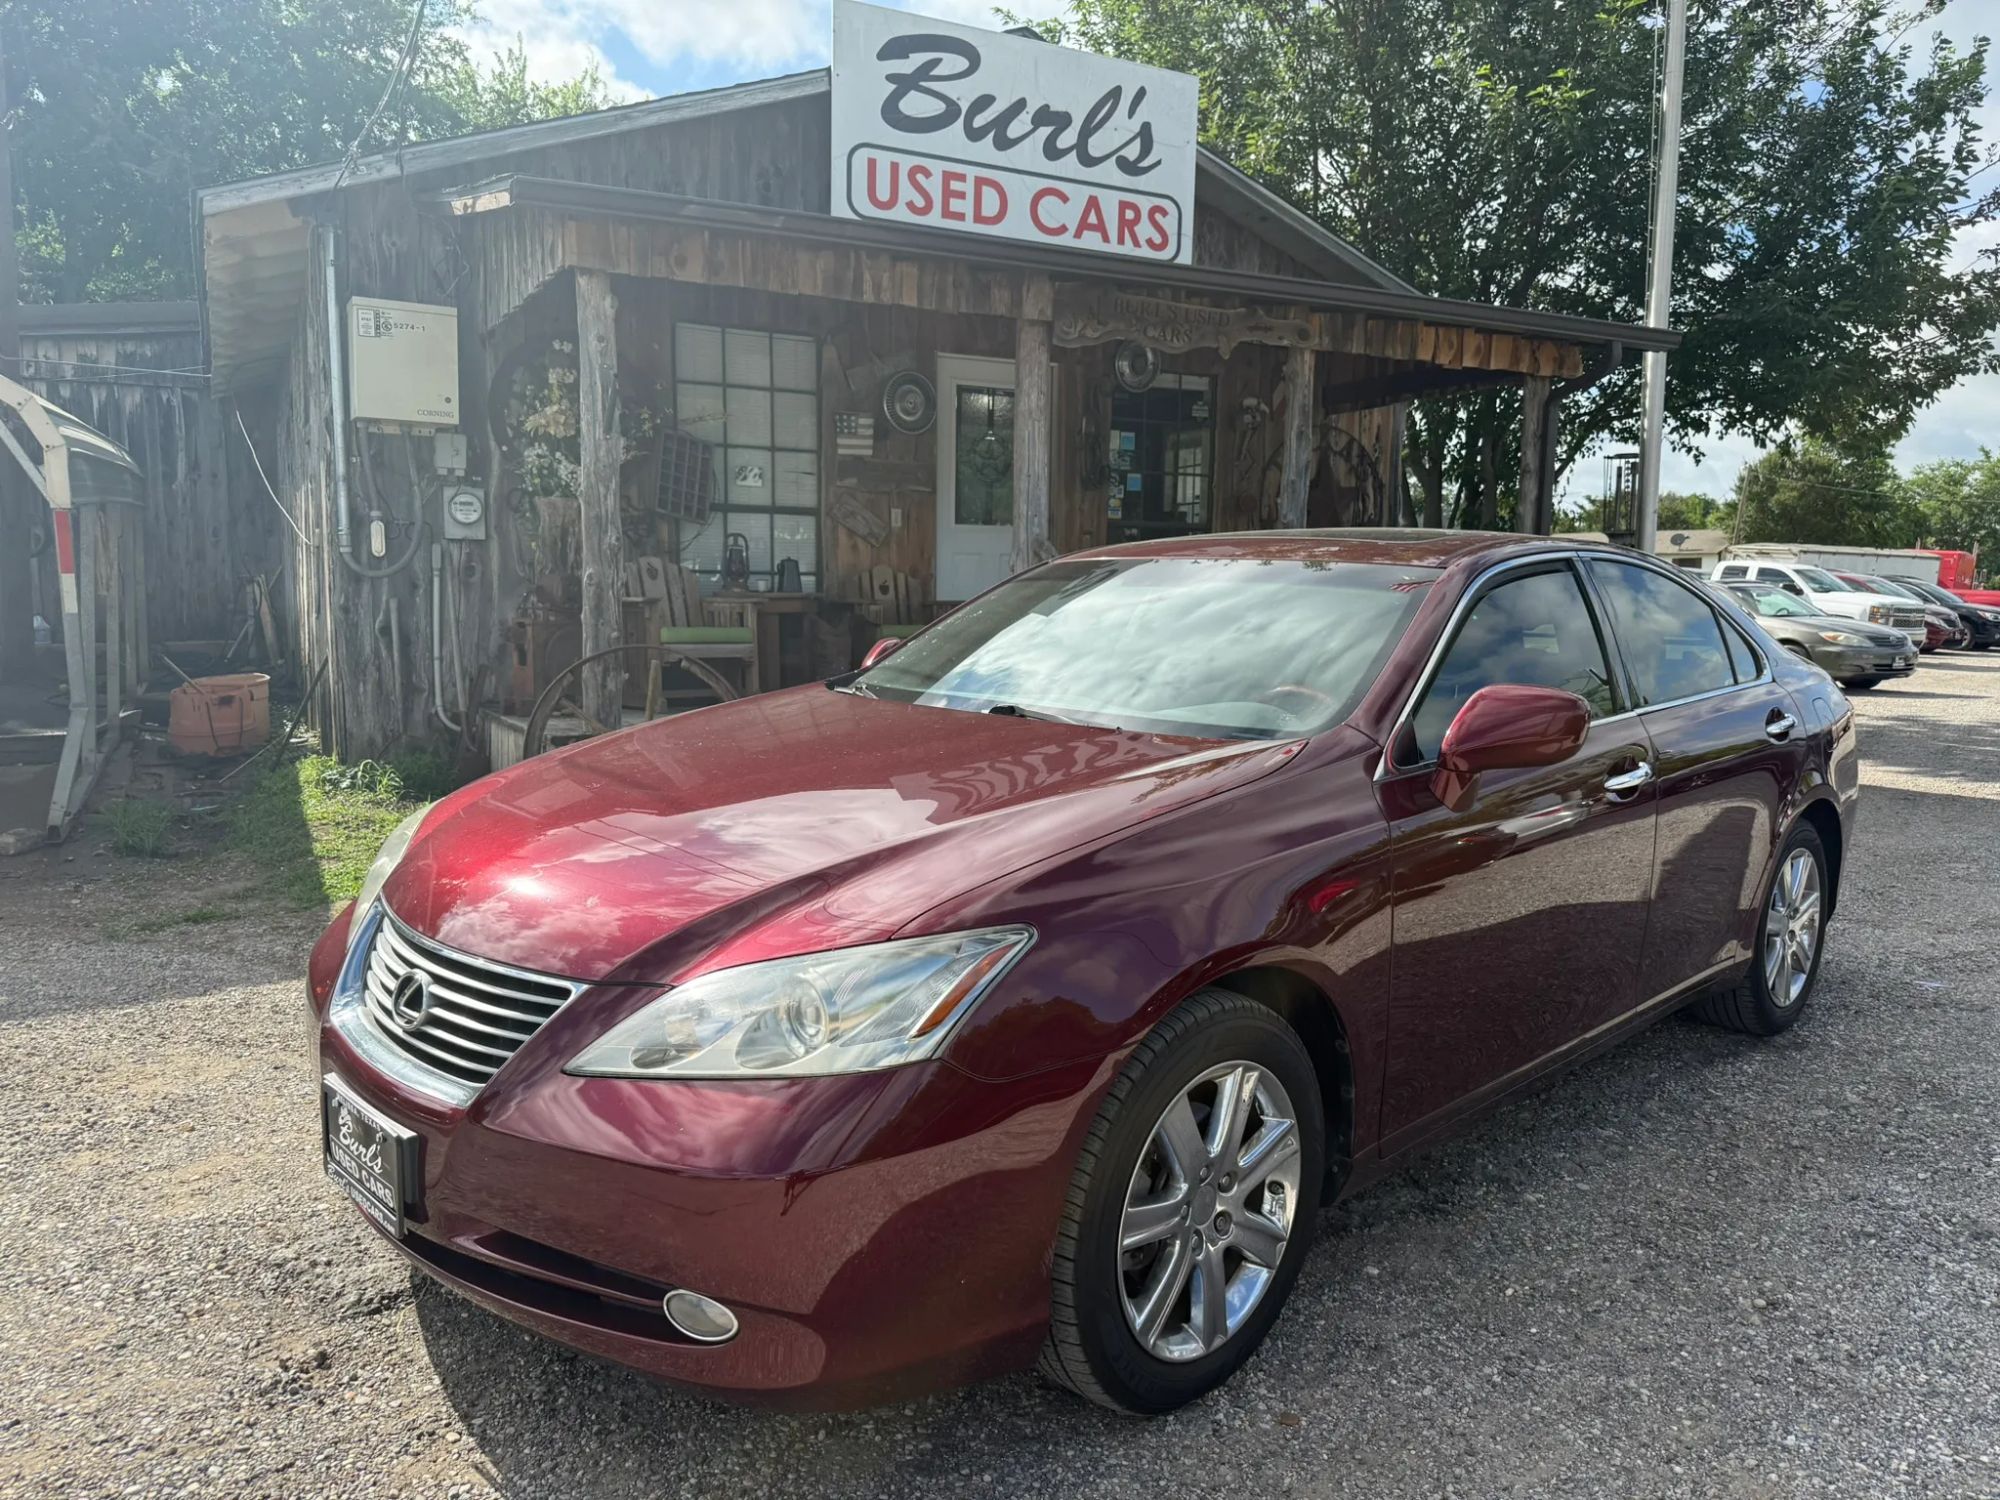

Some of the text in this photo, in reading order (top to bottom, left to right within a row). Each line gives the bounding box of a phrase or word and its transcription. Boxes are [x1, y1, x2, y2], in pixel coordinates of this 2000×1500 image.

[876, 33, 1162, 177] Burl's
[866, 157, 1170, 253] USED CARS
[393, 322, 426, 332] 5274-1
[1143, 325, 1193, 343] CARS
[416, 408, 455, 419] CORNING
[338, 1110, 383, 1174] Burl's
[331, 1141, 394, 1208] USED CARS
